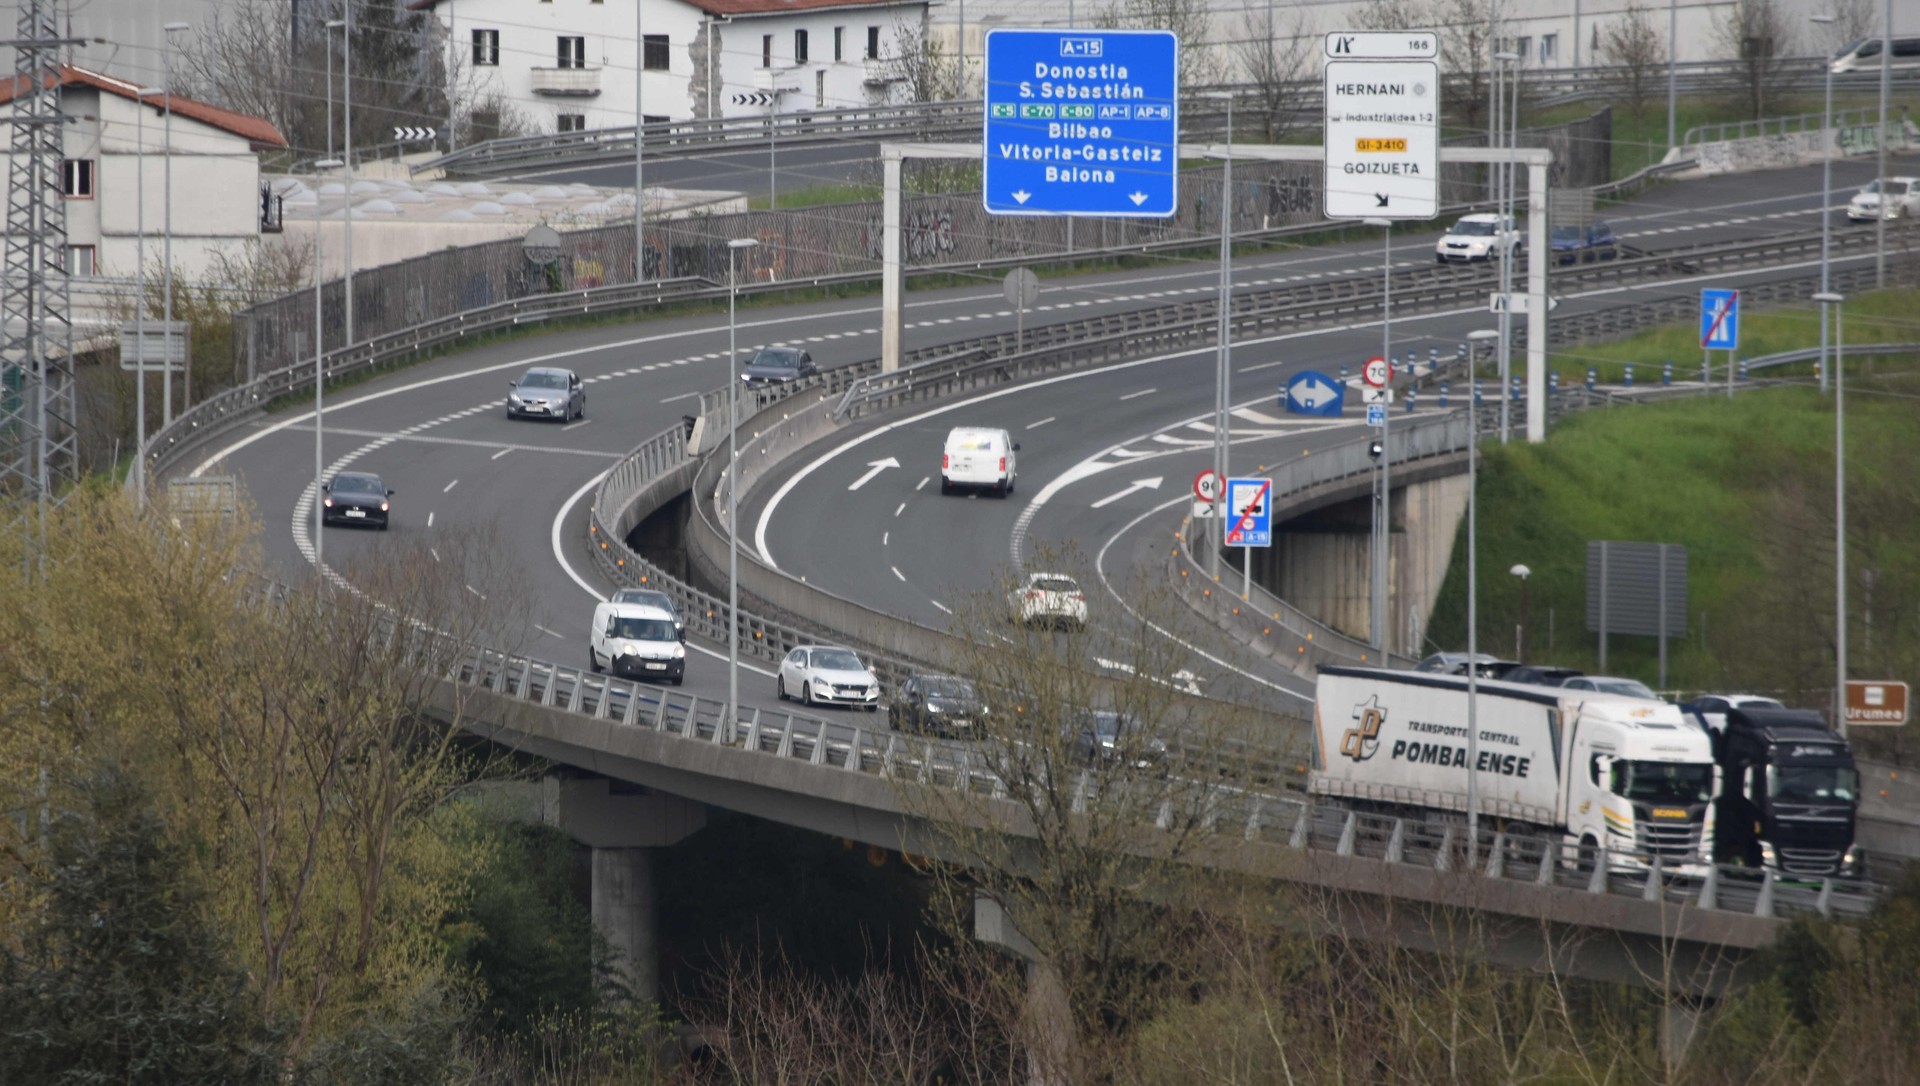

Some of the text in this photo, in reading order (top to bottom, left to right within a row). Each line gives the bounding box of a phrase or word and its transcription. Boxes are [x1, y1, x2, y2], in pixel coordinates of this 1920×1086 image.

[1063, 42, 1100, 54] A-15
[1408, 40, 1428, 50] 166
[1035, 62, 1128, 79] Donostia
[1019, 82, 1144, 99] S. Sebastián
[1336, 83, 1405, 96] HERNANI
[992, 105, 1015, 117] E-5
[1022, 105, 1054, 117] E-70
[1060, 106, 1093, 118] E-80
[1101, 106, 1129, 118] AP-1
[1137, 107, 1169, 118] AP-8
[1346, 113, 1433, 122] Industrialdea 1-2
[1048, 123, 1112, 139] Bilbao
[1357, 140, 1405, 150] GI-3410
[1000, 143, 1162, 162] Vitoria-Gasteiz
[1045, 166, 1115, 183] Baiona
[1343, 162, 1420, 175] GOIZUETA
[1845, 707, 1903, 720] Urumea
[1478, 730, 1520, 746] CENTRAL
